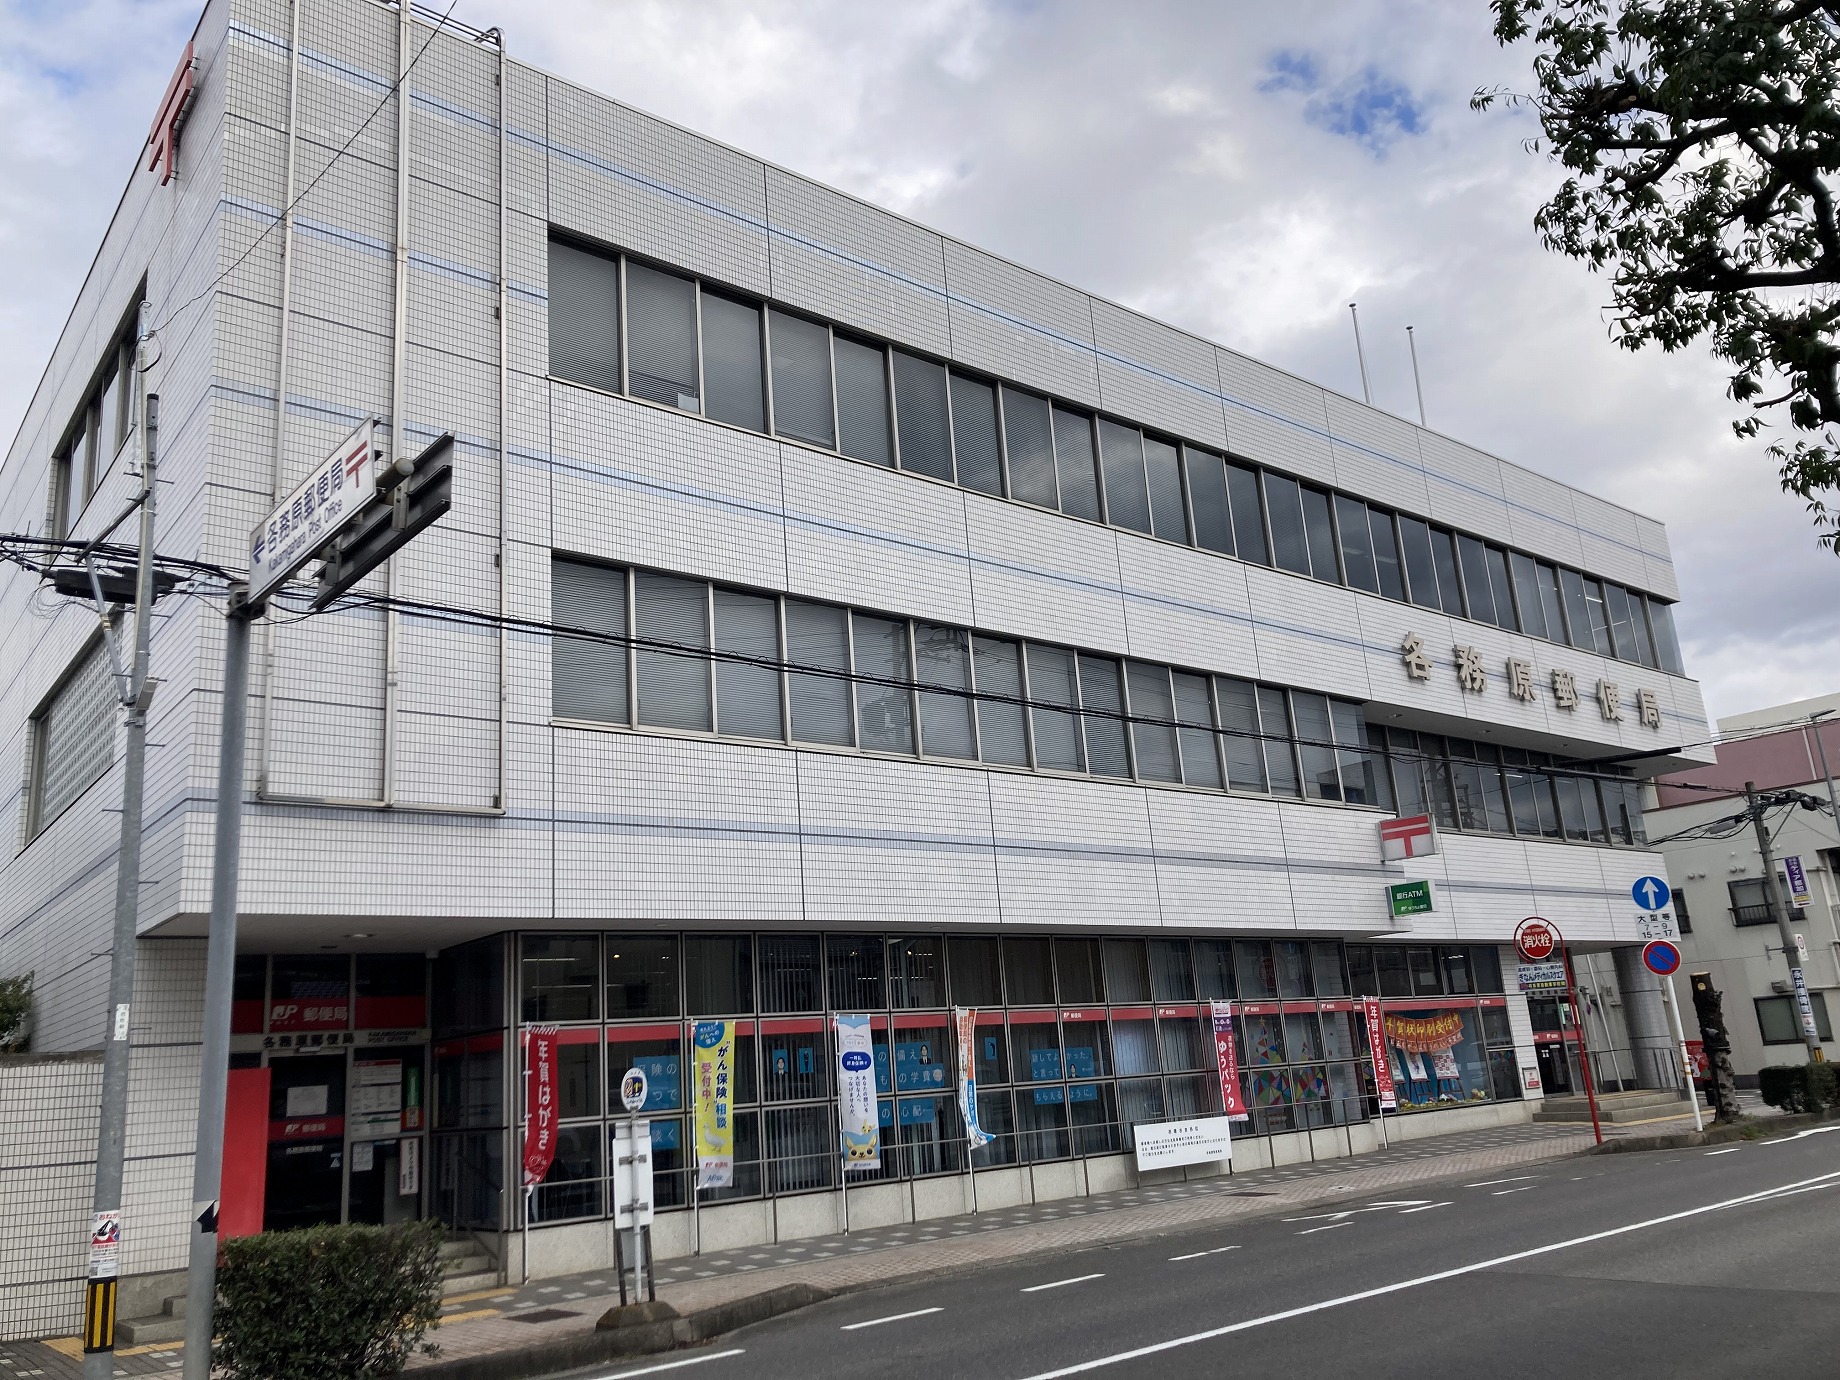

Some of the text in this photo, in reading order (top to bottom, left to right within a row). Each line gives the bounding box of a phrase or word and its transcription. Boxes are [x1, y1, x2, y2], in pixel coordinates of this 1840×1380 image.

[267, 457, 344, 553] 各務原郵便局
[308, 516, 322, 538] Post
[324, 499, 343, 523] Office
[1401, 630, 1663, 729] 各務原郵便局
[1396, 889, 1424, 900] 銀行ATM
[1637, 913, 1670, 923] 大型等
[1523, 933, 1551, 949] 消火栓
[303, 1006, 347, 1021] 郵便局
[1385, 1012, 1460, 1038] 年賀状印刷受付中
[263, 1033, 354, 1048] 各務原郵便局
[1370, 1005, 1385, 1073] 年賀はがき
[1218, 1040, 1235, 1109] ゆうパック
[537, 1039, 553, 1150] 年賀はがき
